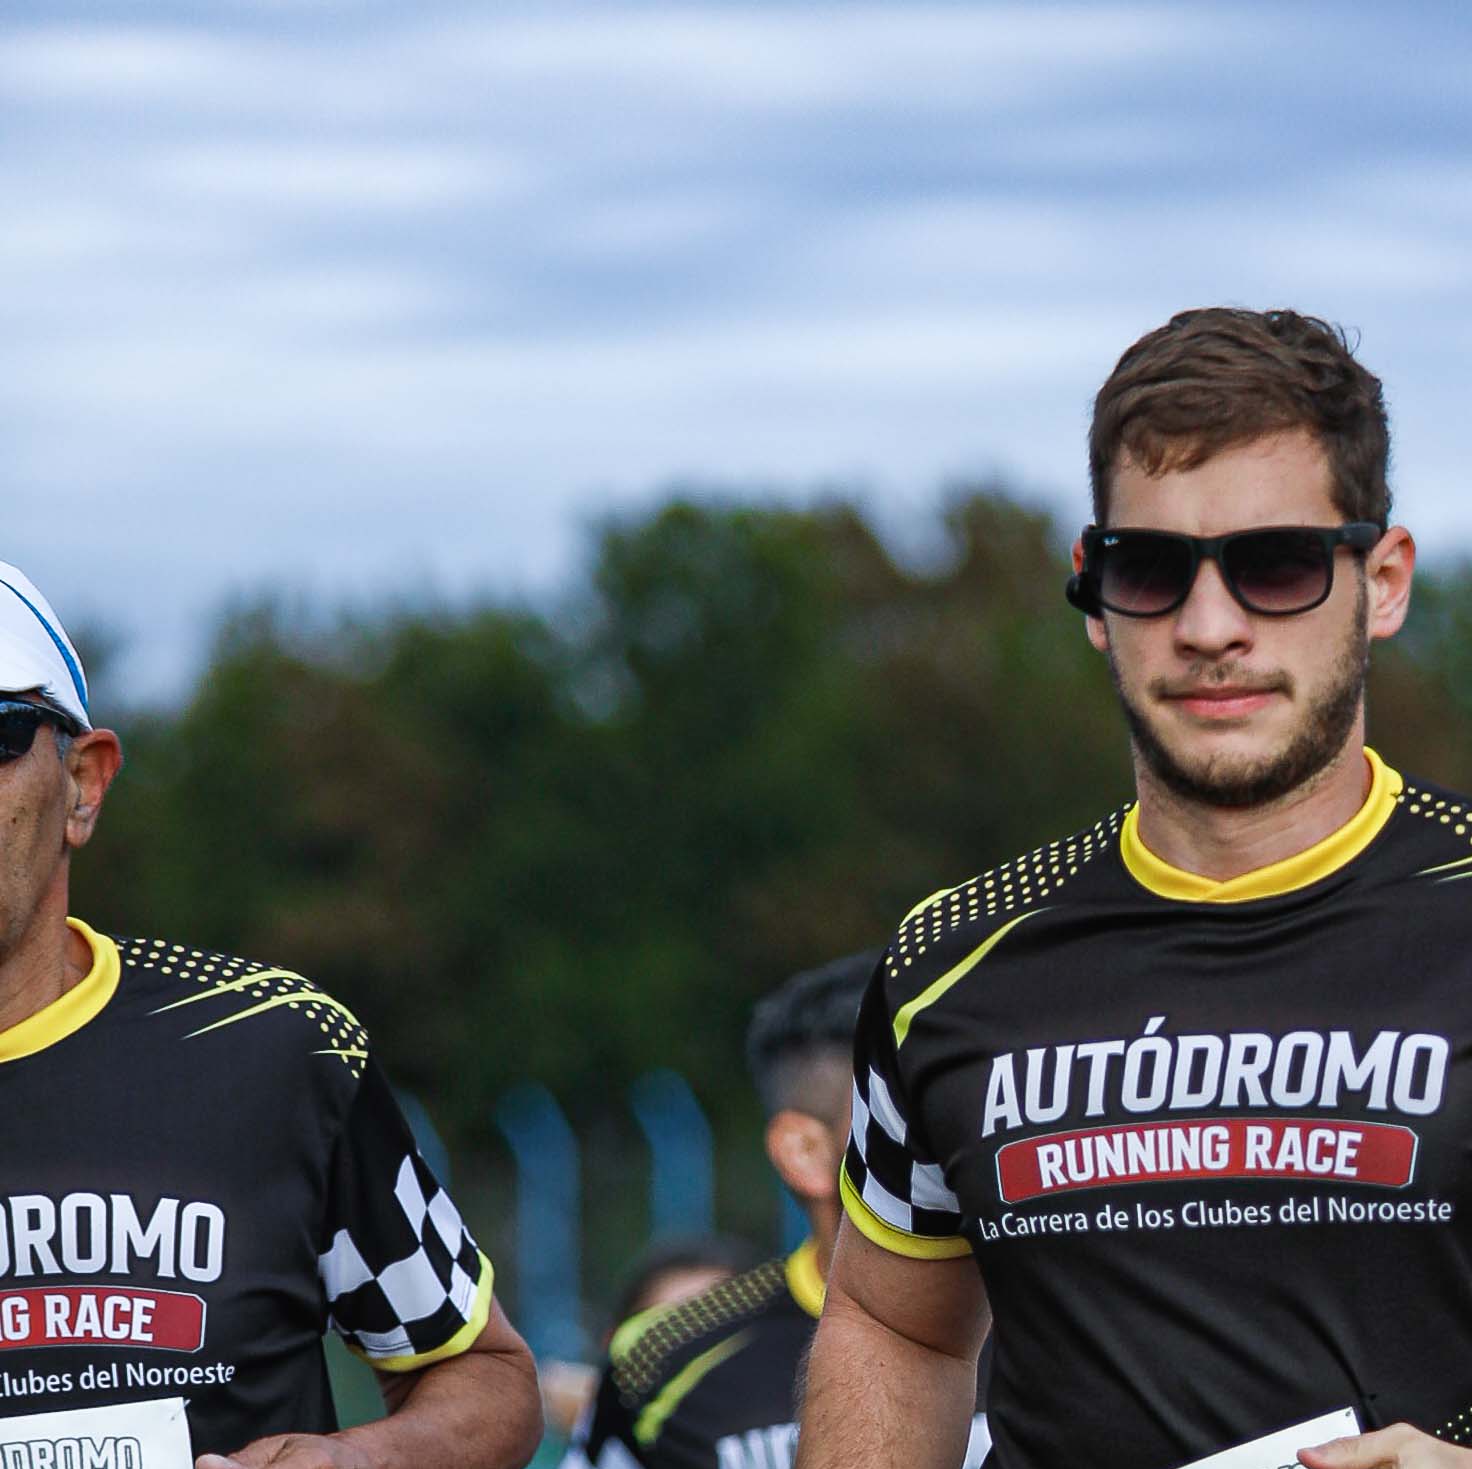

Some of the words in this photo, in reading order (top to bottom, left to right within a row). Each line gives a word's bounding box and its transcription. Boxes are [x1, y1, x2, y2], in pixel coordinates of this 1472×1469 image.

[982, 1016, 1449, 1138] AUTÓDROMO
[1036, 1125, 1230, 1189] RUNNING
[1244, 1125, 1363, 1176] RACE
[0, 1193, 225, 1283] ROMO
[979, 1217, 999, 1241] La
[1002, 1210, 1088, 1236] Carrera
[1096, 1204, 1130, 1230] de
[1137, 1203, 1174, 1229] los
[1181, 1199, 1272, 1227] Clubes
[1278, 1197, 1320, 1224] del
[1328, 1197, 1452, 1223] Noroeste
[44, 1295, 156, 1342] RACE
[79, 1363, 119, 1390] del
[126, 1362, 235, 1387] Noroeste
